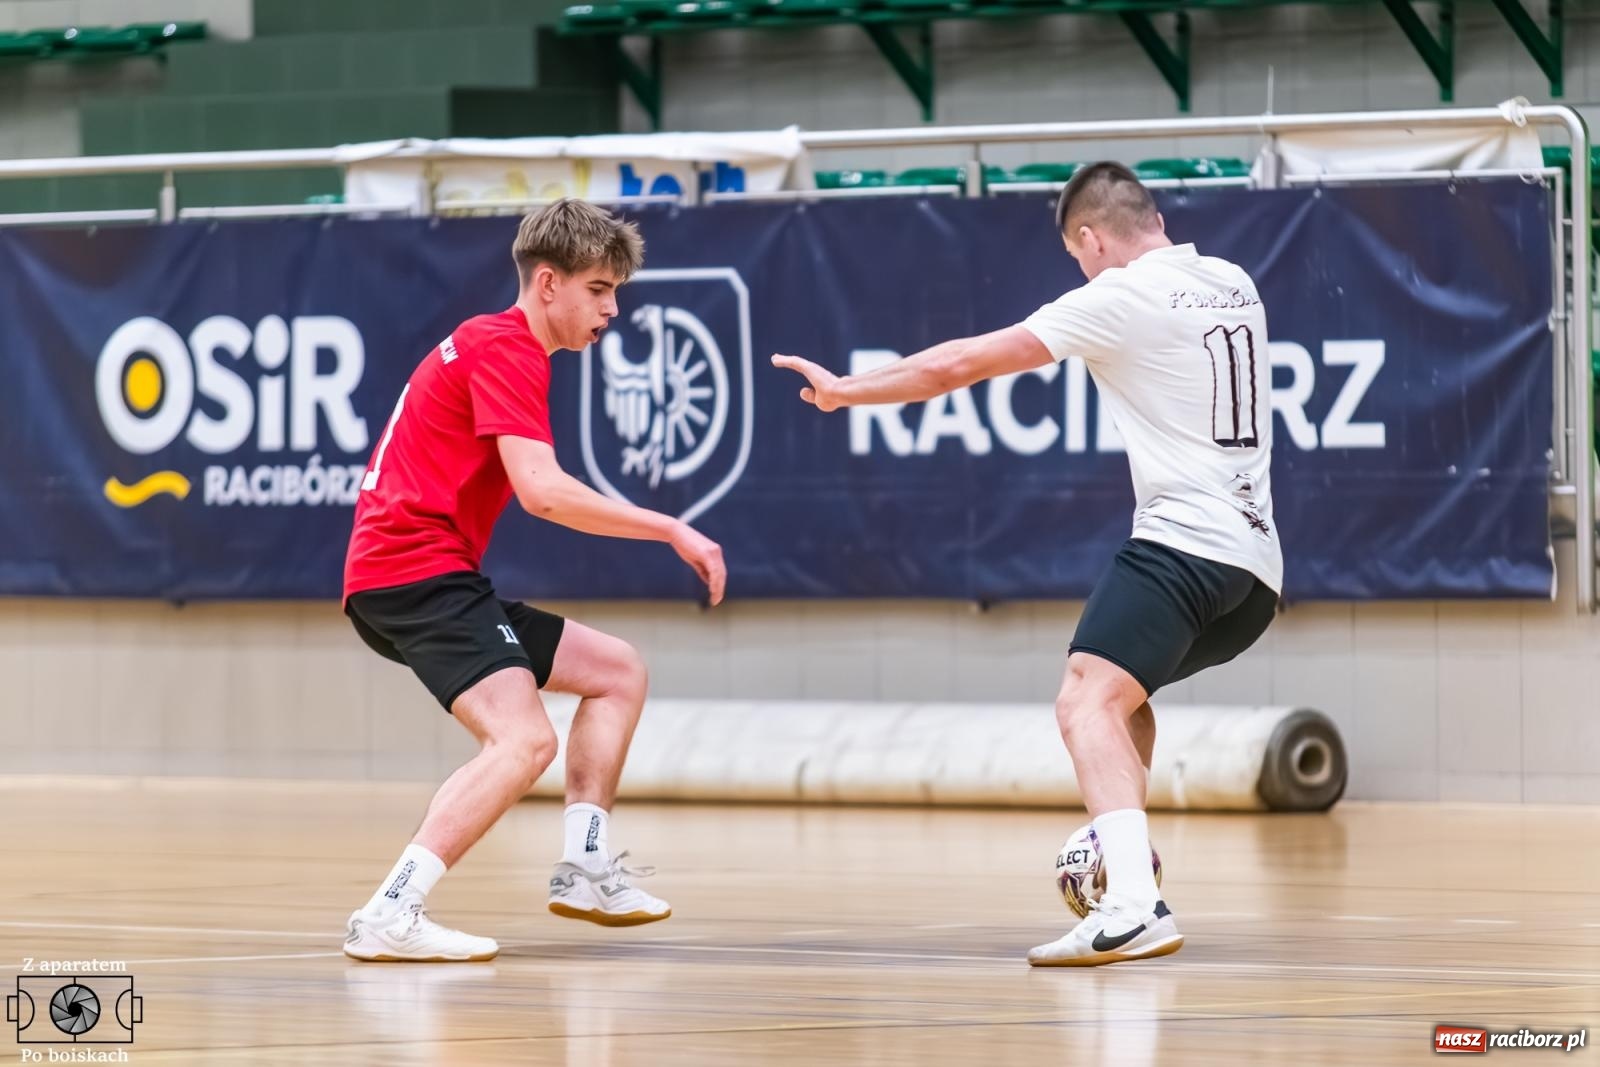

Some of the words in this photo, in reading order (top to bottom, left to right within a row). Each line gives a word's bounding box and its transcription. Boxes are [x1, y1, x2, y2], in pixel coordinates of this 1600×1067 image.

[849, 338, 1386, 456] RACIRZ
[1204, 325, 1258, 448] 11
[203, 453, 366, 506] RACIBÓRZ
[497, 625, 519, 645] 11
[1056, 849, 1090, 868] ELECT
